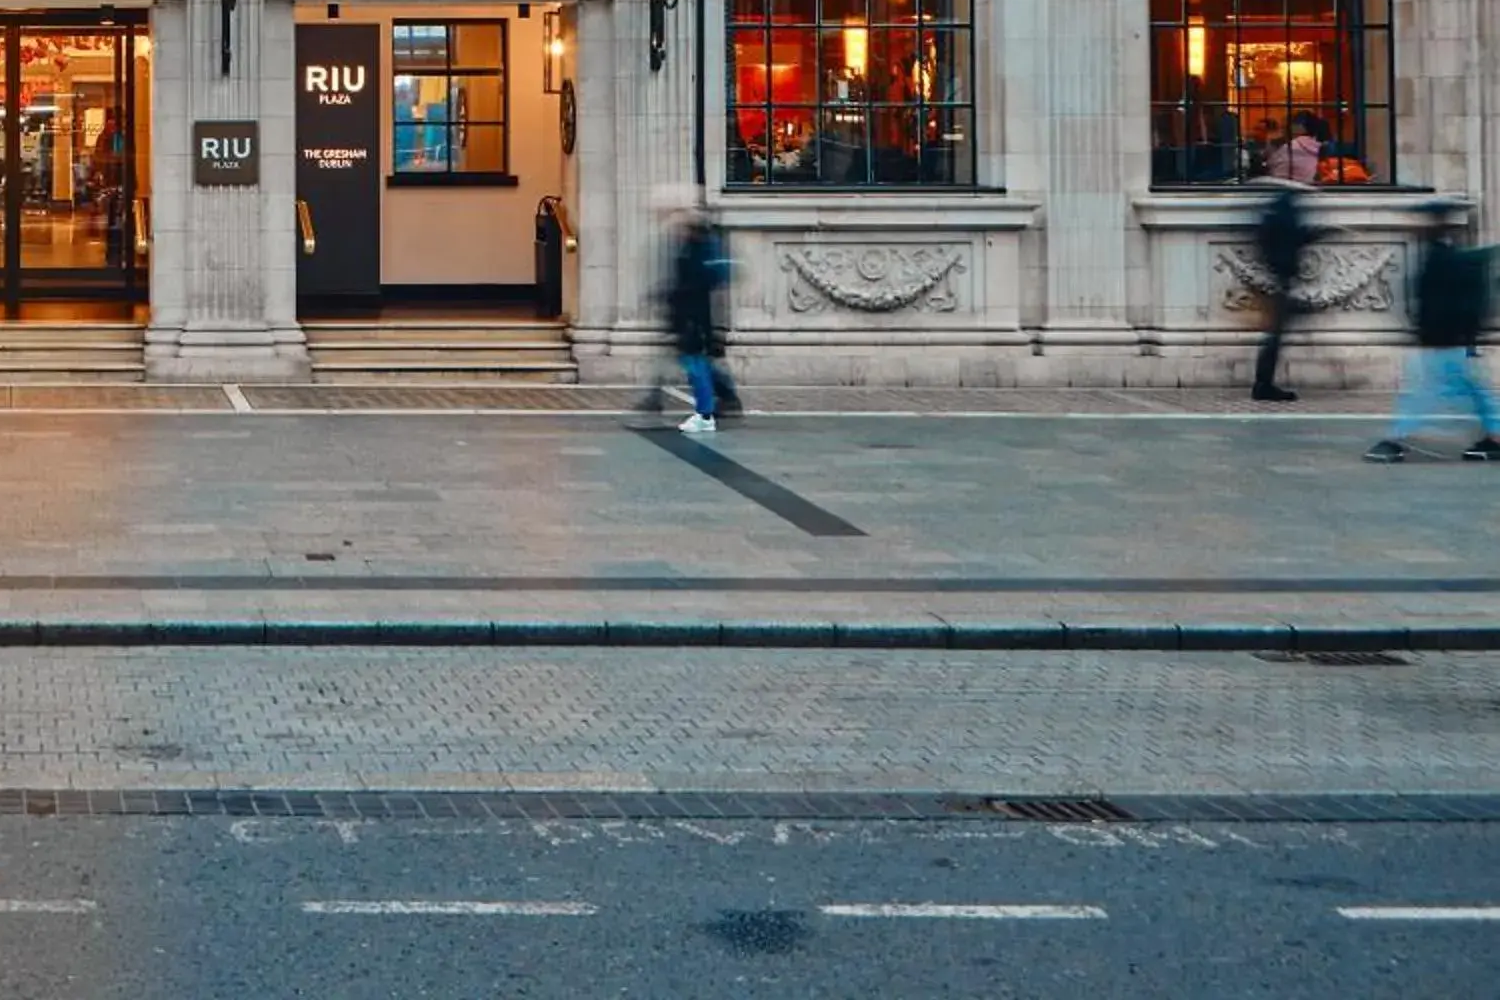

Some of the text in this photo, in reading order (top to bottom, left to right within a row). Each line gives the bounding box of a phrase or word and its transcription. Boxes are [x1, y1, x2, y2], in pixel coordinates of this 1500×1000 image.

[305, 65, 365, 92] RIU
[319, 94, 351, 105] PLAZA
[201, 137, 251, 159] RIU
[304, 149, 367, 159] THE GRESHAM
